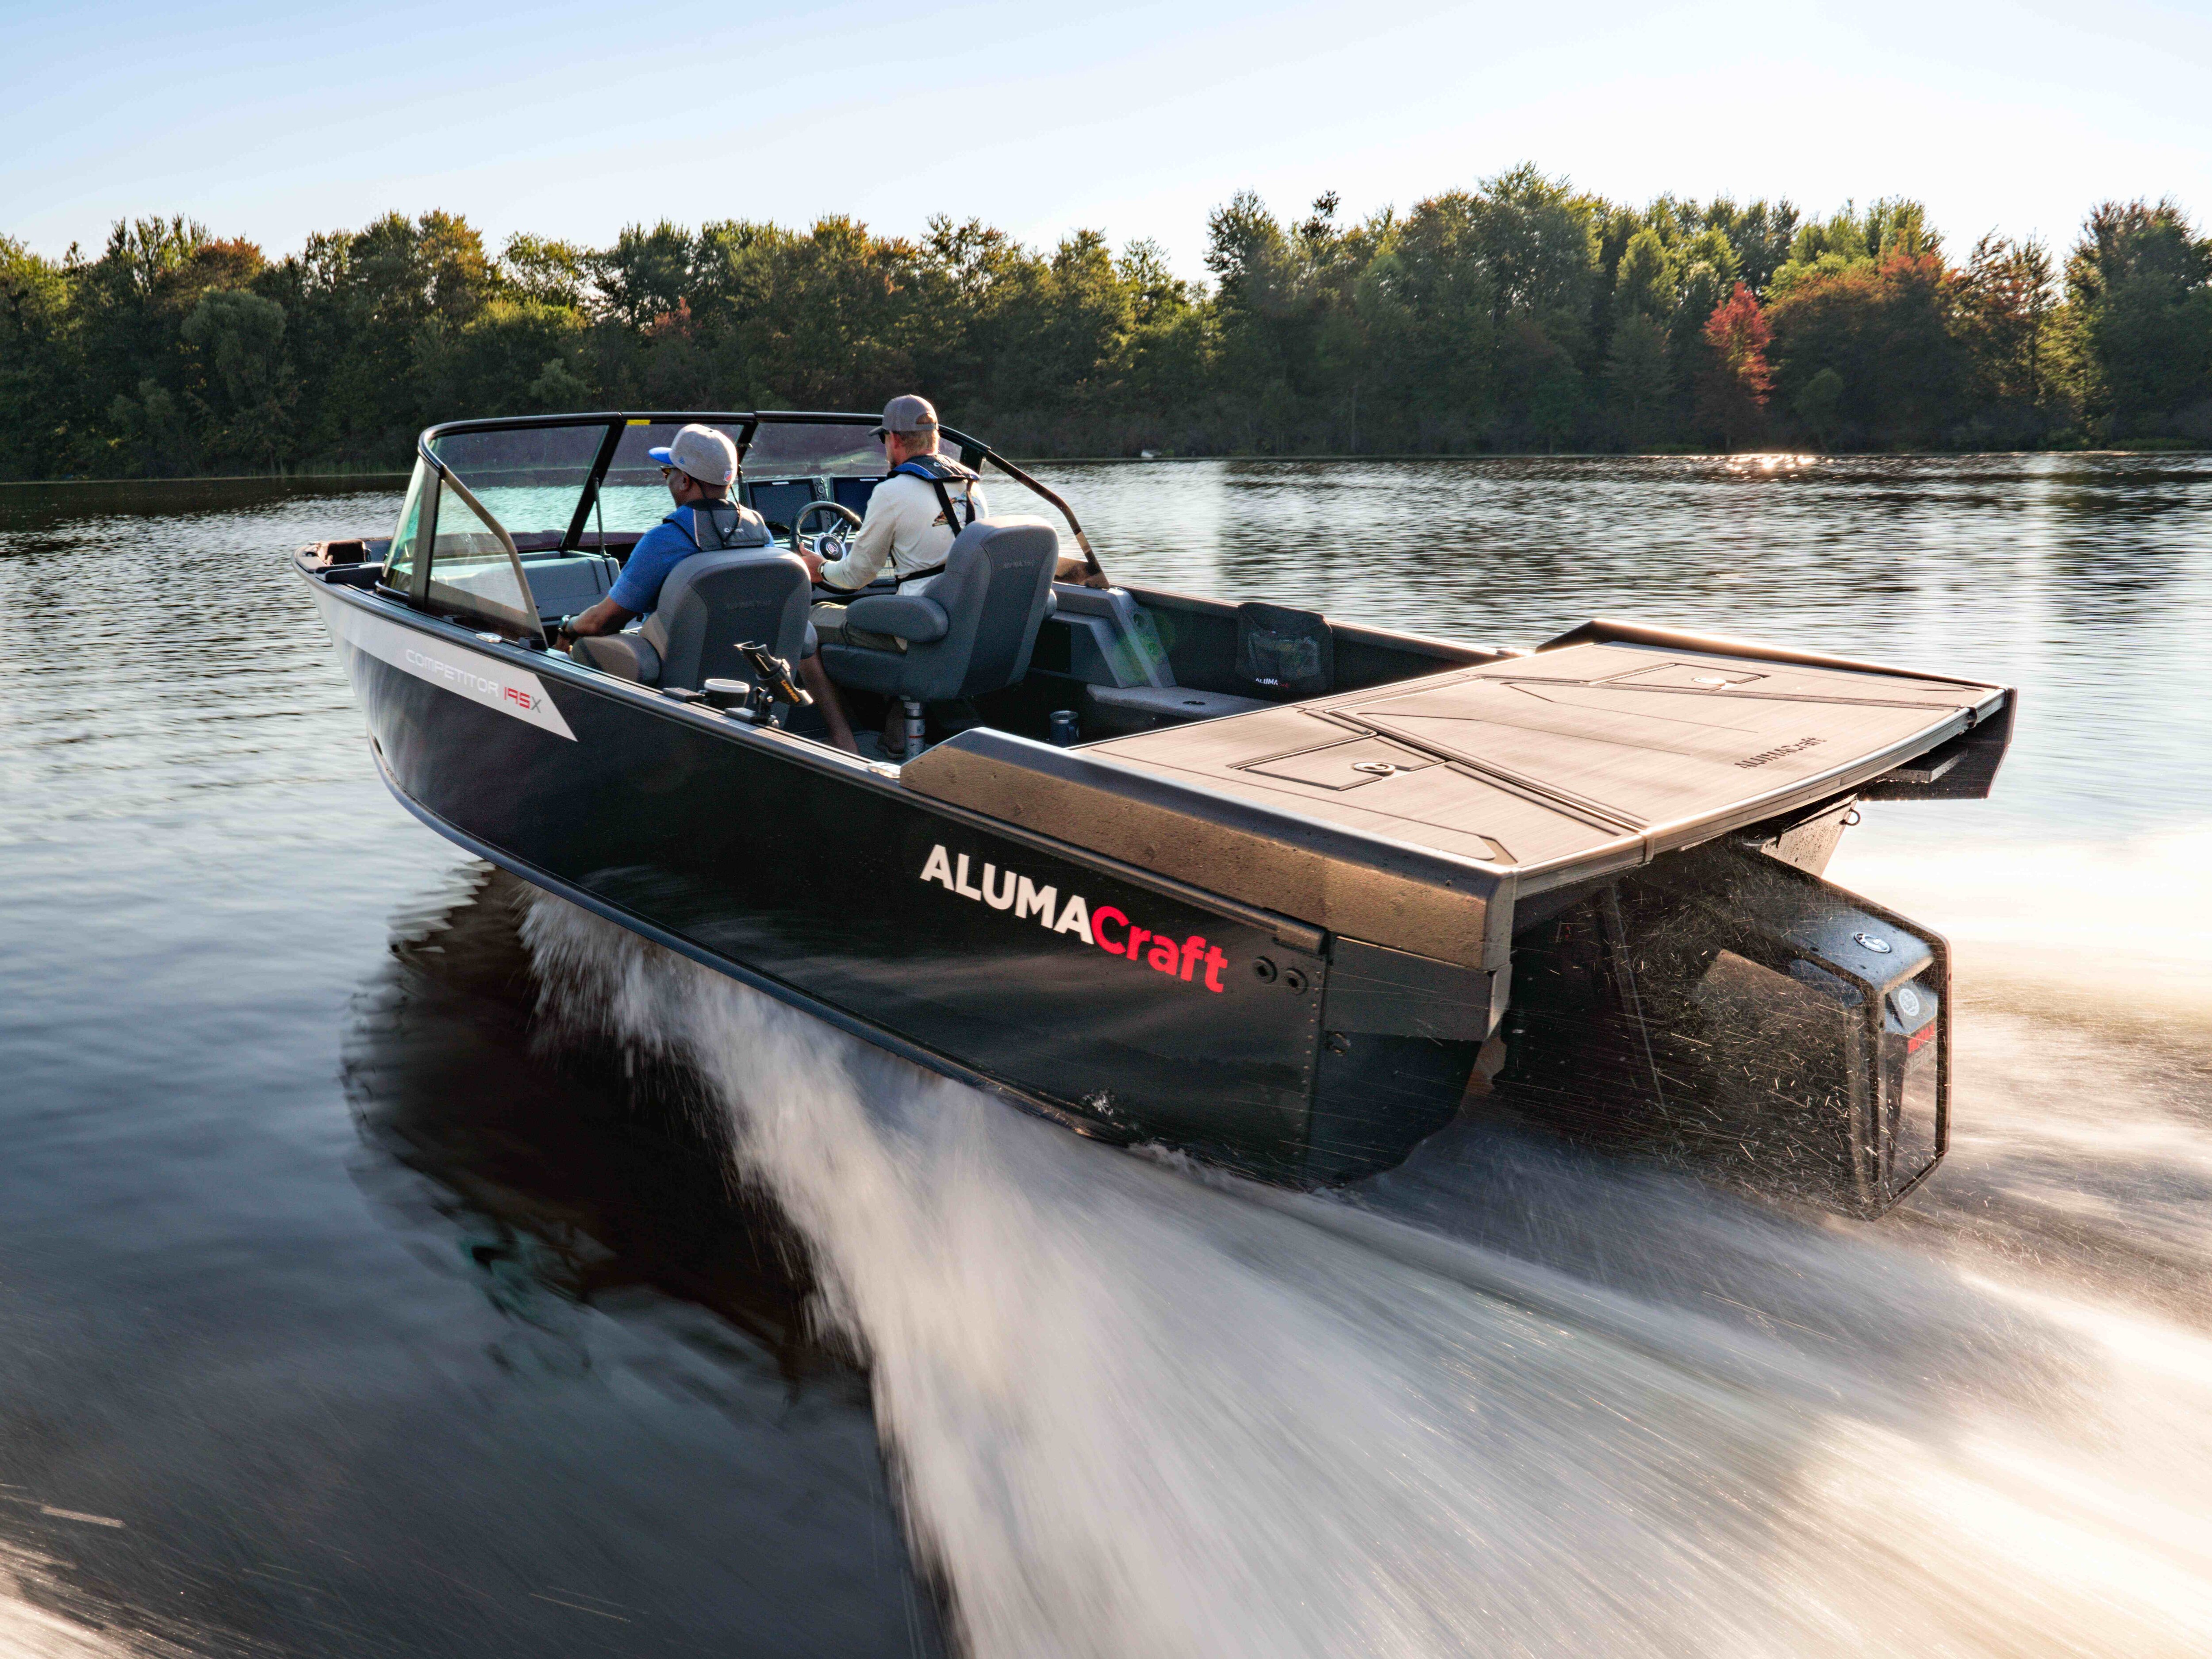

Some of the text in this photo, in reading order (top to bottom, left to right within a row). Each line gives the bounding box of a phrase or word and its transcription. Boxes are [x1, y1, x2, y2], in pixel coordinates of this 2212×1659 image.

[406, 649, 541, 714] COMPETITOR 195X
[919, 844, 1228, 993] ALUMACraft
